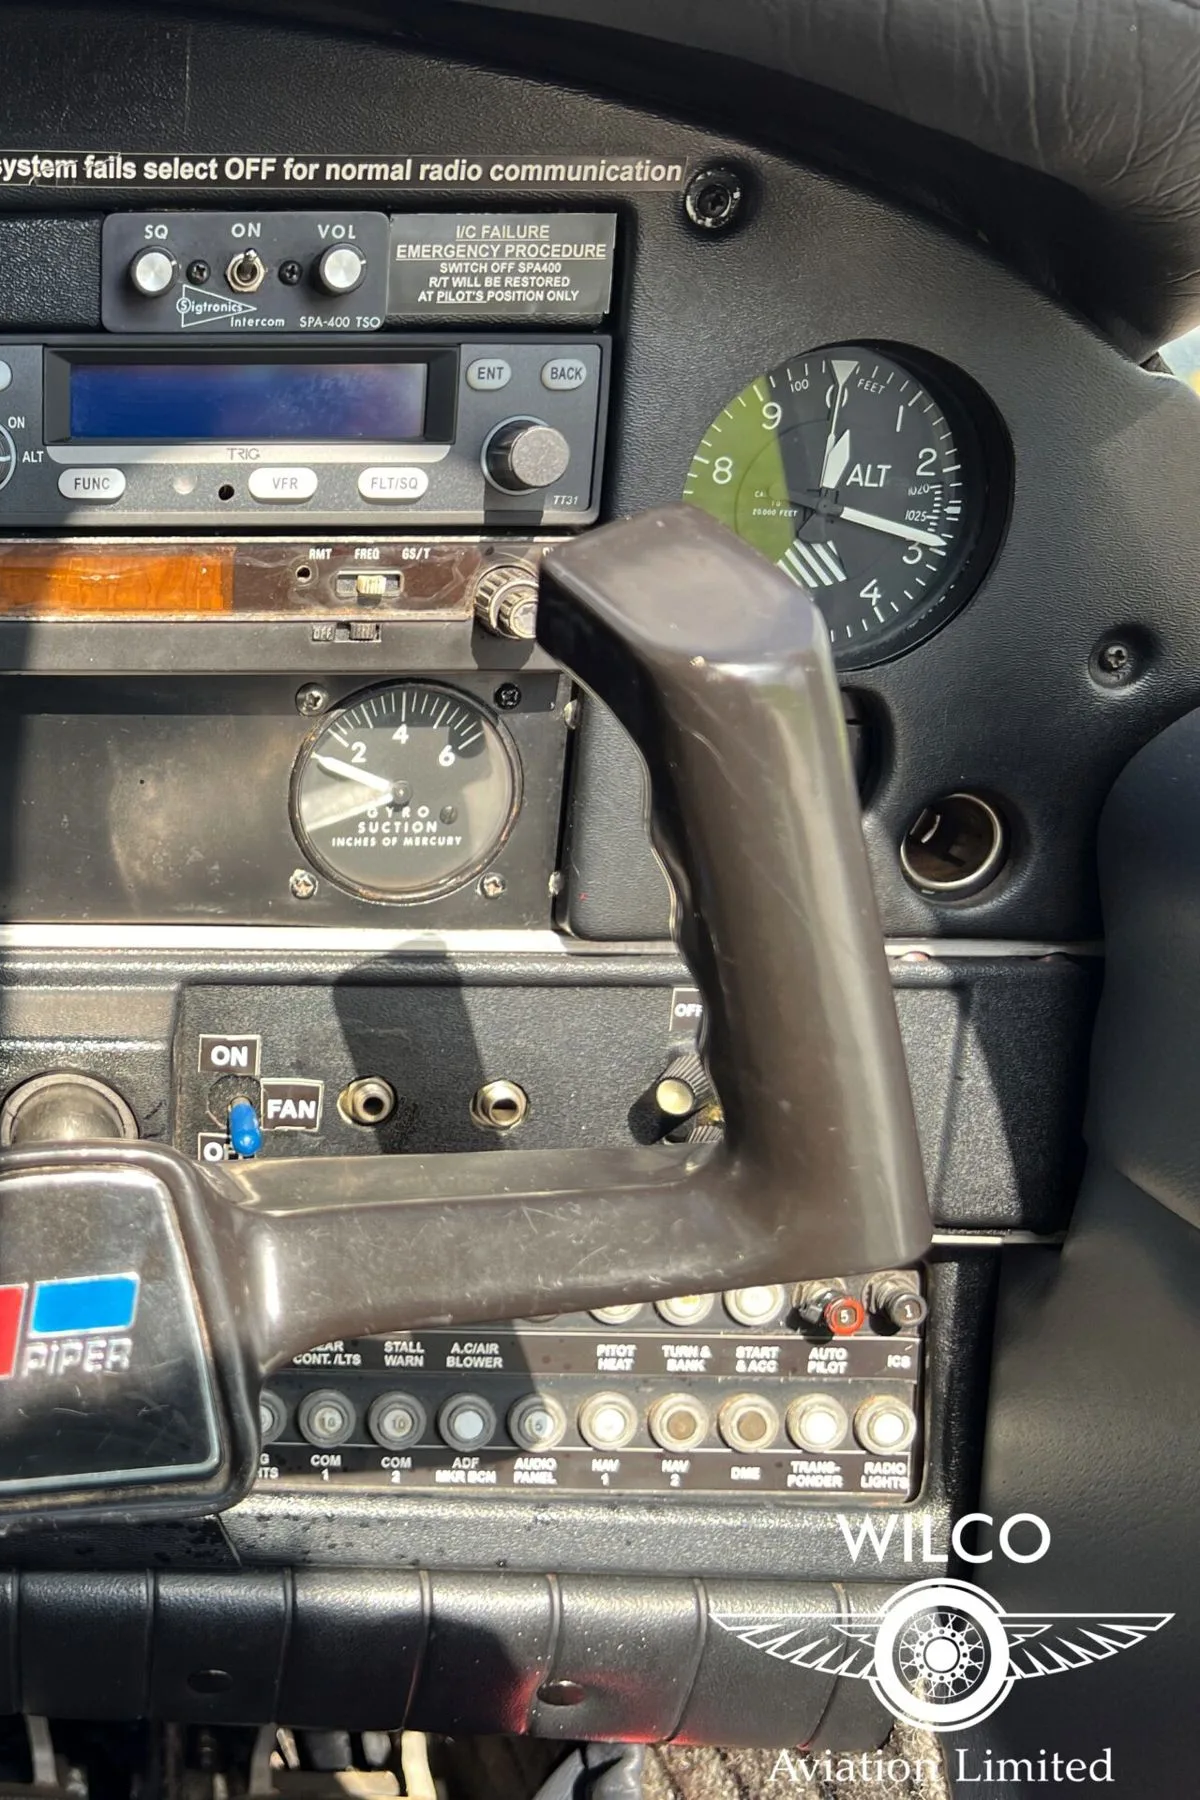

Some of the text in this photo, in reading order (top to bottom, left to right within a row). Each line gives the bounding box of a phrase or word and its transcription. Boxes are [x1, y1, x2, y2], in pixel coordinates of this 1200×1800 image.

[84, 155, 137, 179] fails
[143, 157, 218, 180] select
[225, 158, 277, 180] OFF
[283, 158, 319, 181] for
[325, 159, 412, 182] normal
[419, 159, 481, 182] radio
[489, 160, 682, 183] communication
[144, 224, 169, 239] SQ
[231, 223, 261, 238] ON
[318, 224, 356, 239] VOL
[456, 225, 550, 240] I/C FAILURE
[396, 244, 606, 259] EMERGENCY PROCEDURE
[440, 262, 562, 273] SWITCH OFF SPA400
[429, 276, 570, 288] R/T WILL BE RESTORED
[418, 290, 579, 302] AT PILOT'S POSITION ONLY
[300, 317, 381, 328] SPA-400 TSO
[477, 367, 504, 380] ENT
[550, 367, 583, 380] BACK
[761, 402, 783, 430] 9
[8, 417, 25, 429] ON
[22, 451, 44, 463] ALT
[916, 448, 937, 476] 2
[846, 464, 891, 488] ALT
[74, 478, 110, 491] FUNC
[272, 478, 298, 489] VFR
[371, 478, 418, 490] FLT/SQ
[553, 495, 578, 505] TT31
[905, 509, 927, 521] 1025
[391, 724, 409, 744] 4
[350, 742, 367, 763] 2
[439, 744, 456, 767] 6
[367, 806, 430, 819] GYRO
[358, 821, 437, 834] SUCTION
[331, 836, 462, 846] INCHES OF MERCURY
[210, 1046, 247, 1067] ON
[267, 1099, 316, 1119] FAN
[384, 1341, 424, 1353] STALL
[736, 1346, 779, 1359] START
[21, 1338, 132, 1378] PIPER
[809, 1347, 848, 1361] AUTO
[384, 1355, 424, 1367] WARN
[446, 1357, 503, 1368] BLOWER
[808, 1361, 848, 1374] PILOT
[310, 1455, 341, 1466] COM
[381, 1457, 412, 1468] COM
[452, 1457, 479, 1469] ADF
[864, 1462, 907, 1475] RADIO
[787, 1475, 843, 1488] PONDER
[861, 1475, 909, 1489] LIGHTS
